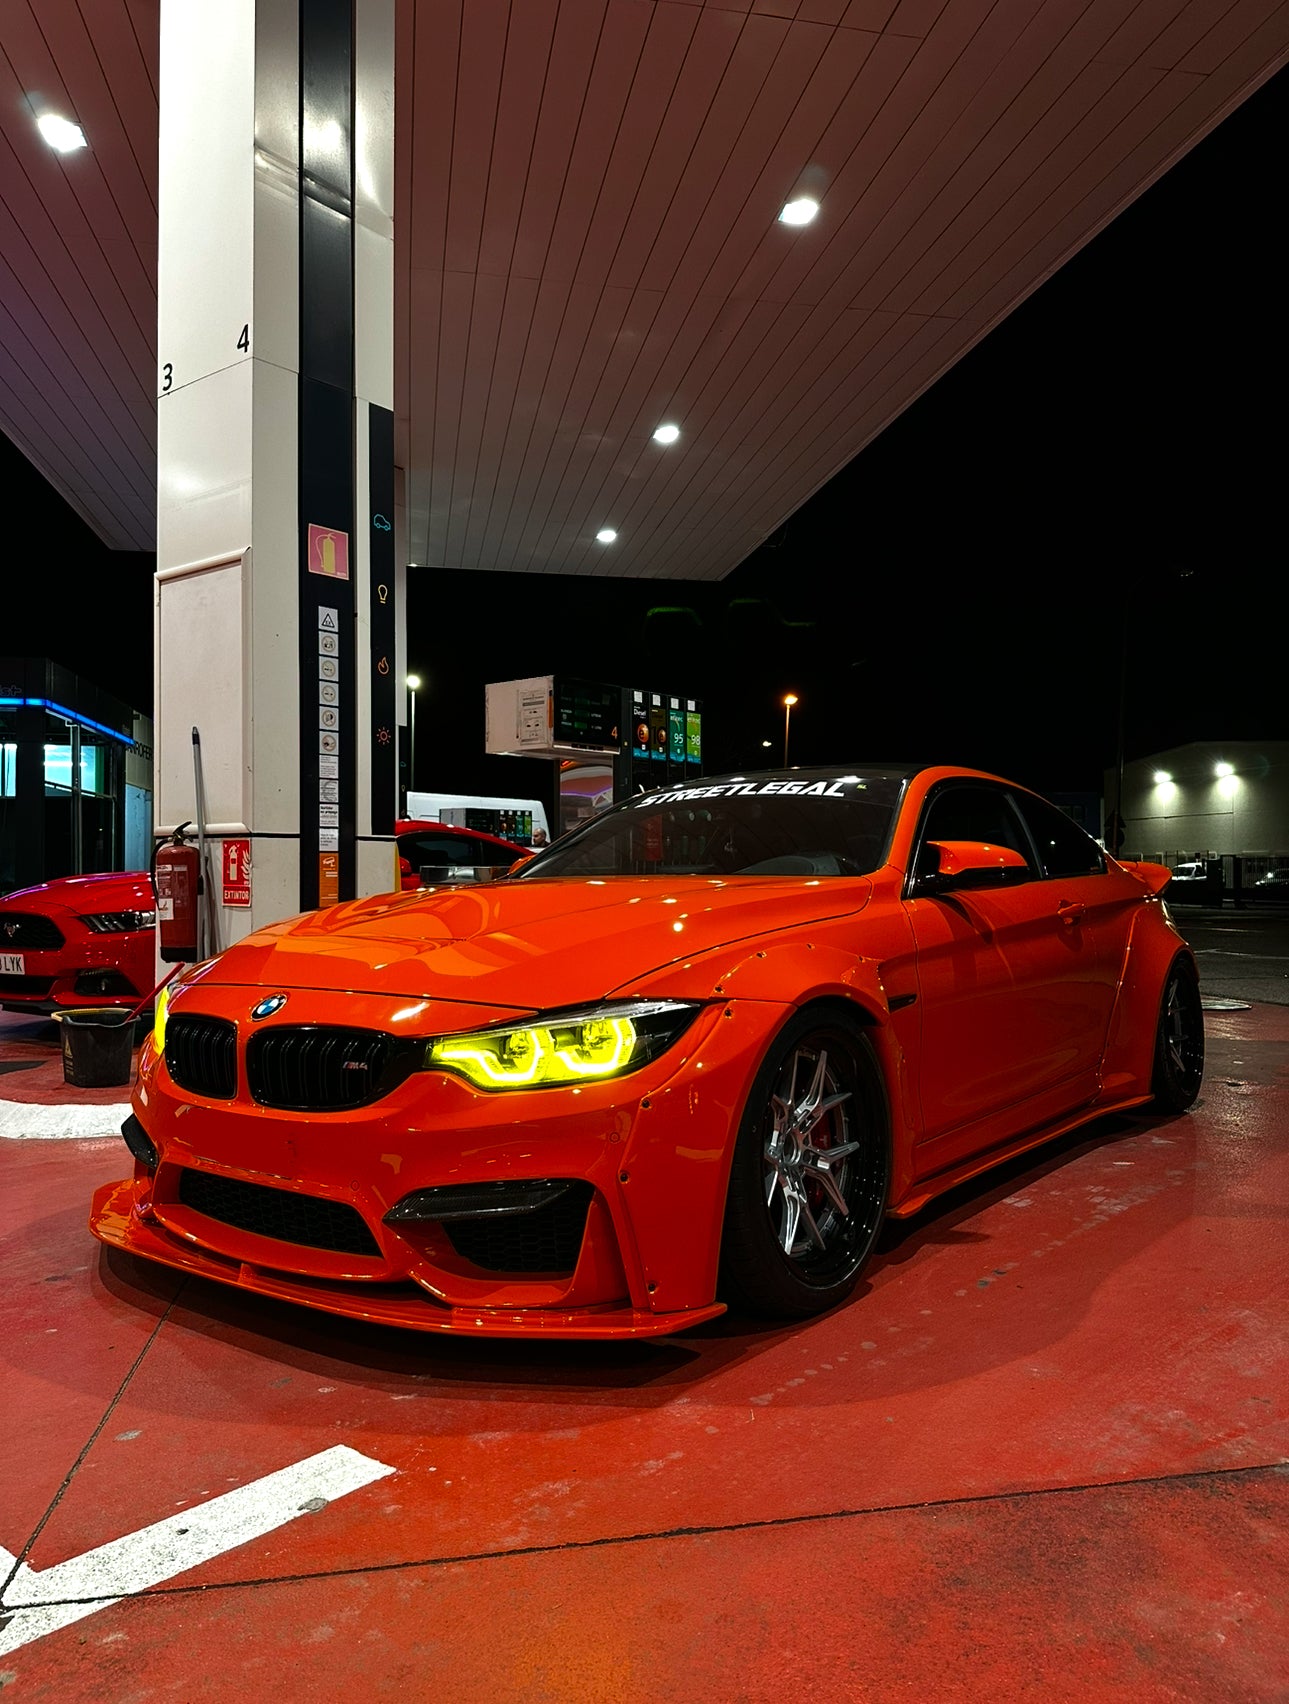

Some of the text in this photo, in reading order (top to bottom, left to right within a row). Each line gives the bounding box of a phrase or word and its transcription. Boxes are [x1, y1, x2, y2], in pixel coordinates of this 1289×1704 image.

[237, 324, 250, 353] 4
[162, 363, 173, 391] 3
[611, 726, 619, 740] 4
[673, 732, 684, 744] 95
[691, 734, 702, 745] 98
[634, 781, 845, 809] STREETLEGAL
[224, 889, 250, 900] EXTINTOR
